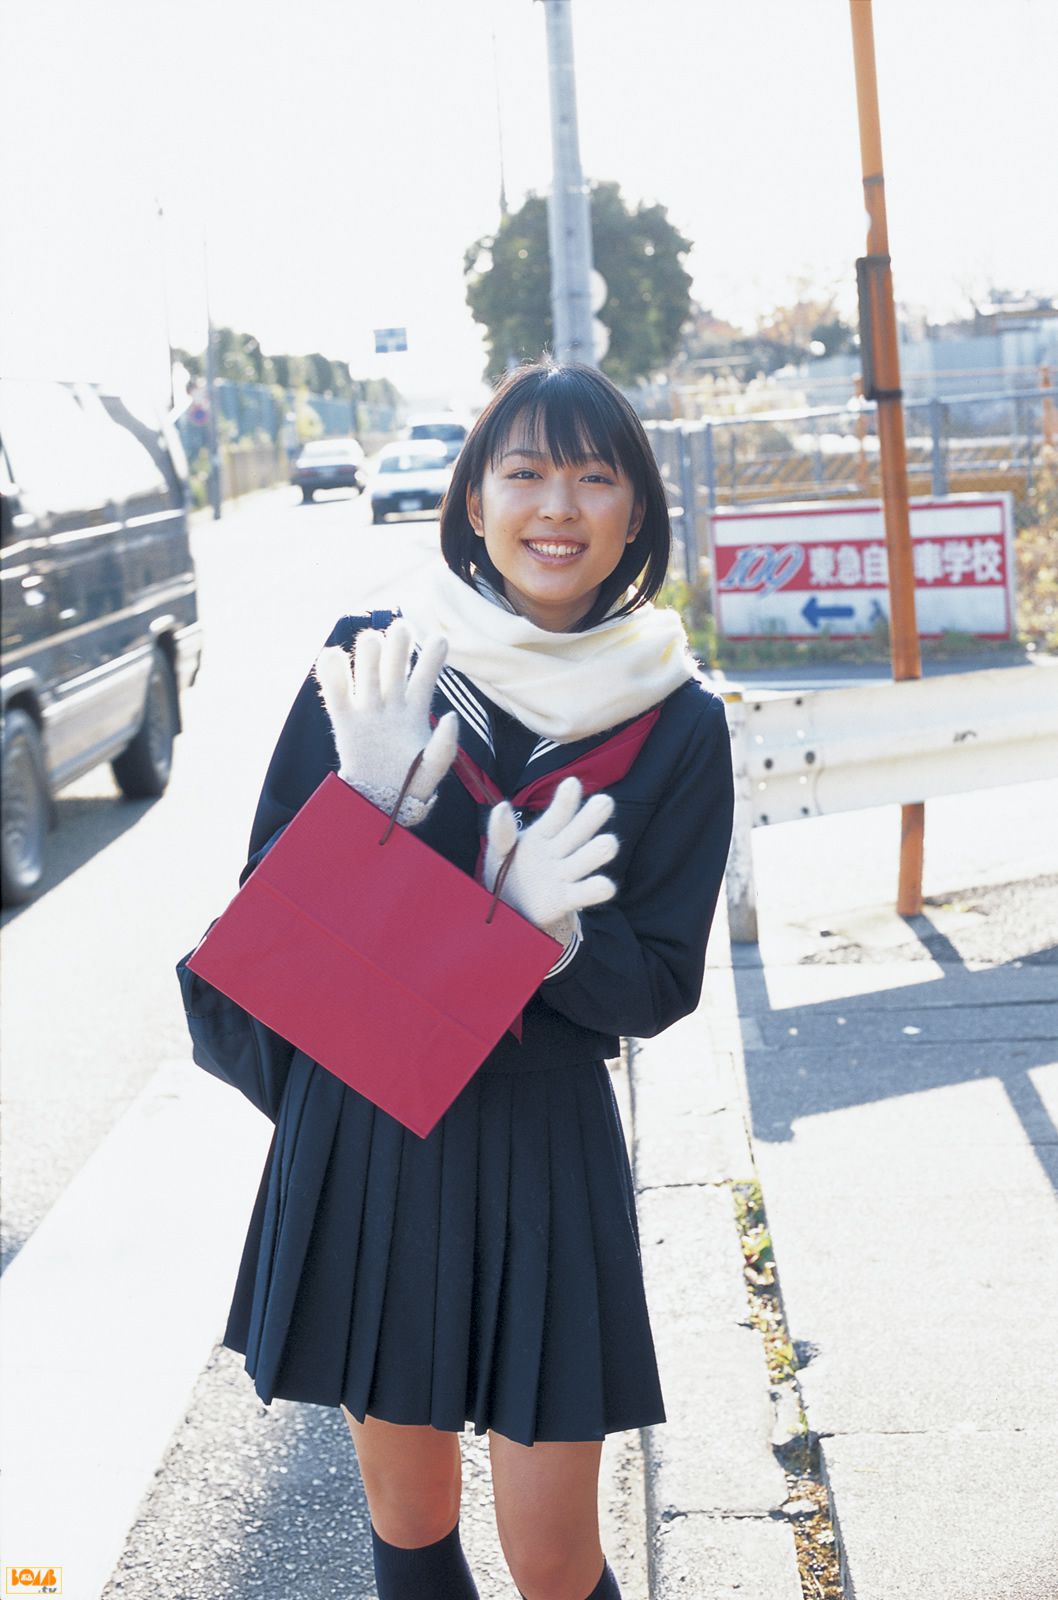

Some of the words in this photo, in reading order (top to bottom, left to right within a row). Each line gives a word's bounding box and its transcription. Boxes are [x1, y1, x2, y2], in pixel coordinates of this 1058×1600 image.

[809, 539, 1003, 586] 東急自車学校
